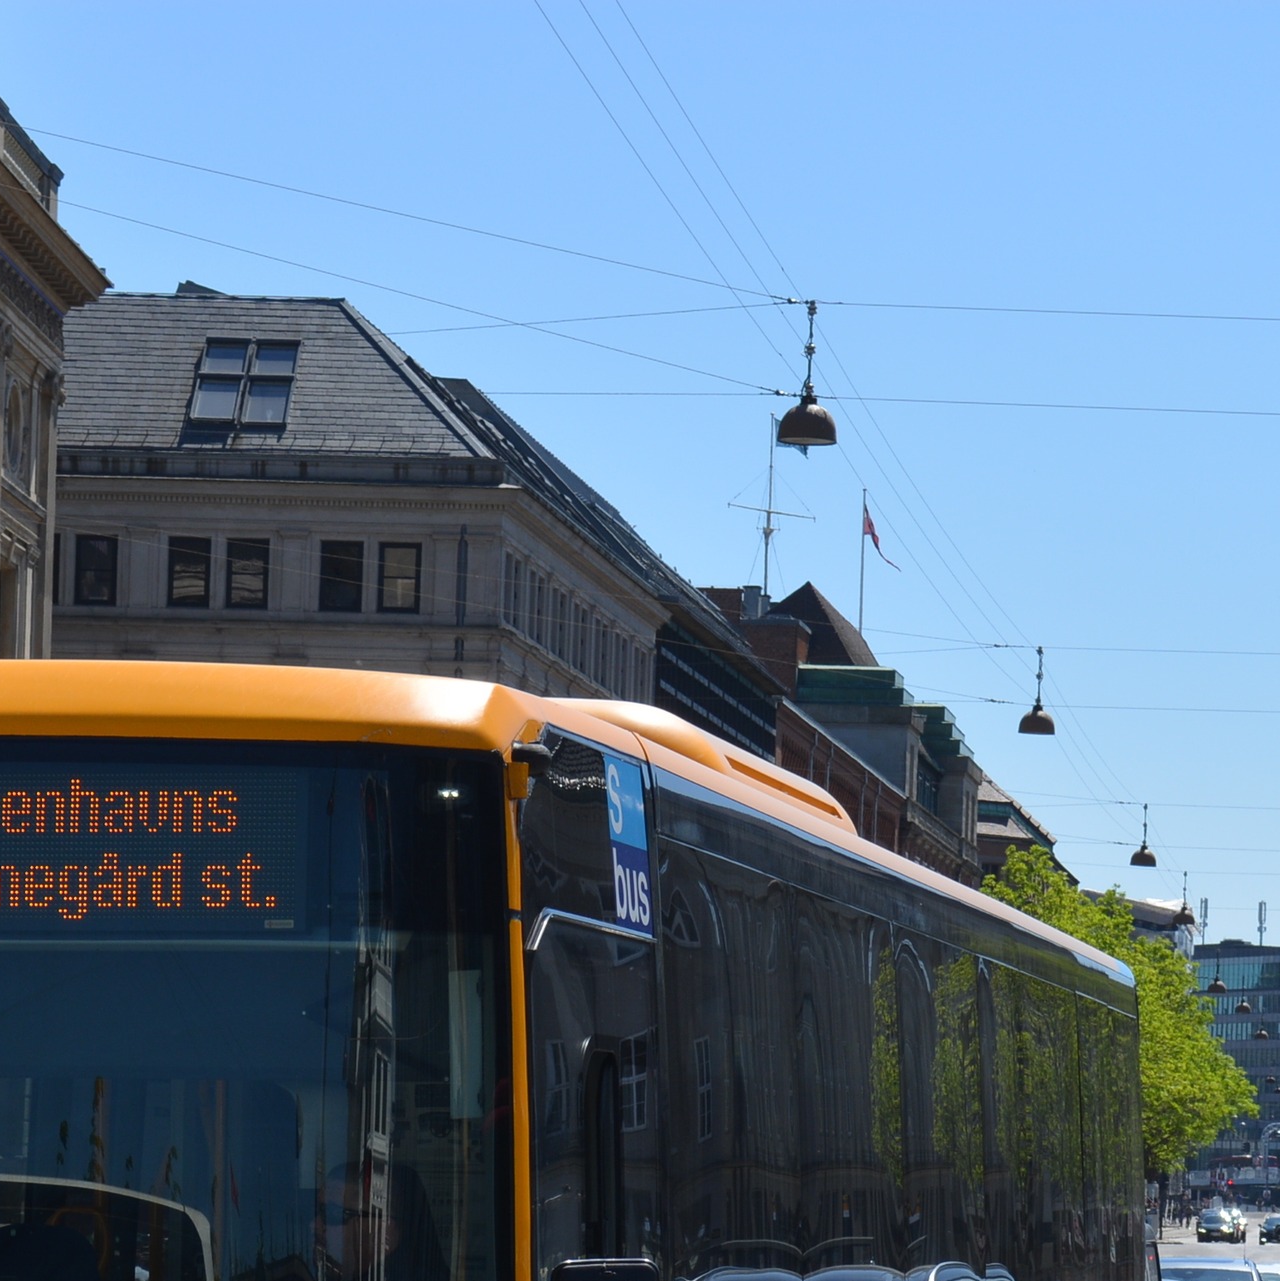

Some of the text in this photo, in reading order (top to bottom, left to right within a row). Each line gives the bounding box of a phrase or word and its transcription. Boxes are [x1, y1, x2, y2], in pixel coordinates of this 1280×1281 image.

[606, 763, 623, 835] S
[201, 852, 276, 908] st.
[612, 847, 650, 927] bus
